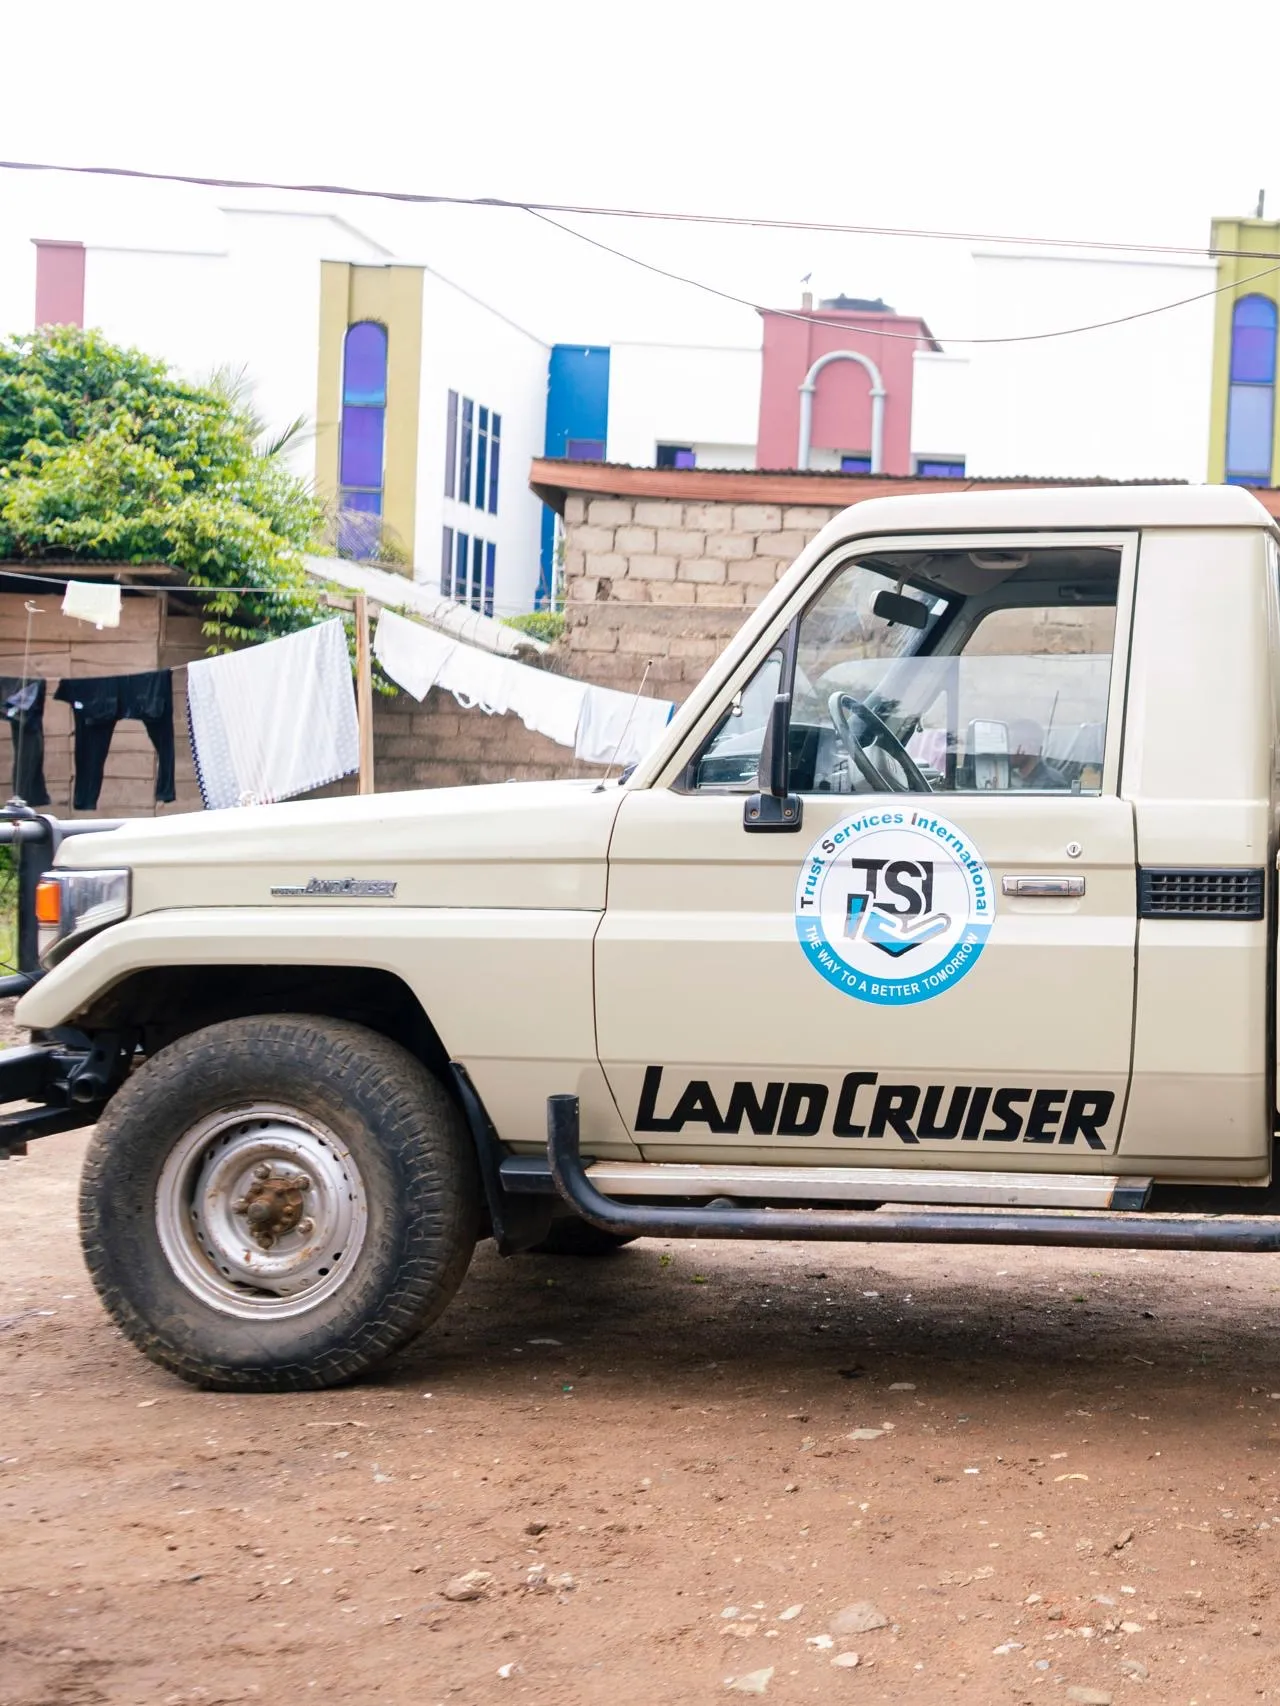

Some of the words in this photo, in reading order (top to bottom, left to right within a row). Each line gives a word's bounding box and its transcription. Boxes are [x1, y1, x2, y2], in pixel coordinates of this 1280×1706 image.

[800, 856, 825, 908] Trust
[821, 813, 904, 854] Services
[911, 812, 989, 916] International
[851, 858, 934, 915] TSI
[805, 924, 822, 950] THE
[817, 949, 841, 975] WAY
[840, 970, 857, 987] TO
[858, 981, 867, 993] A
[871, 982, 921, 997] BETTER
[921, 931, 979, 990] TOMORROW
[634, 1065, 830, 1136] LAND
[832, 1072, 1116, 1151] CRUISER
